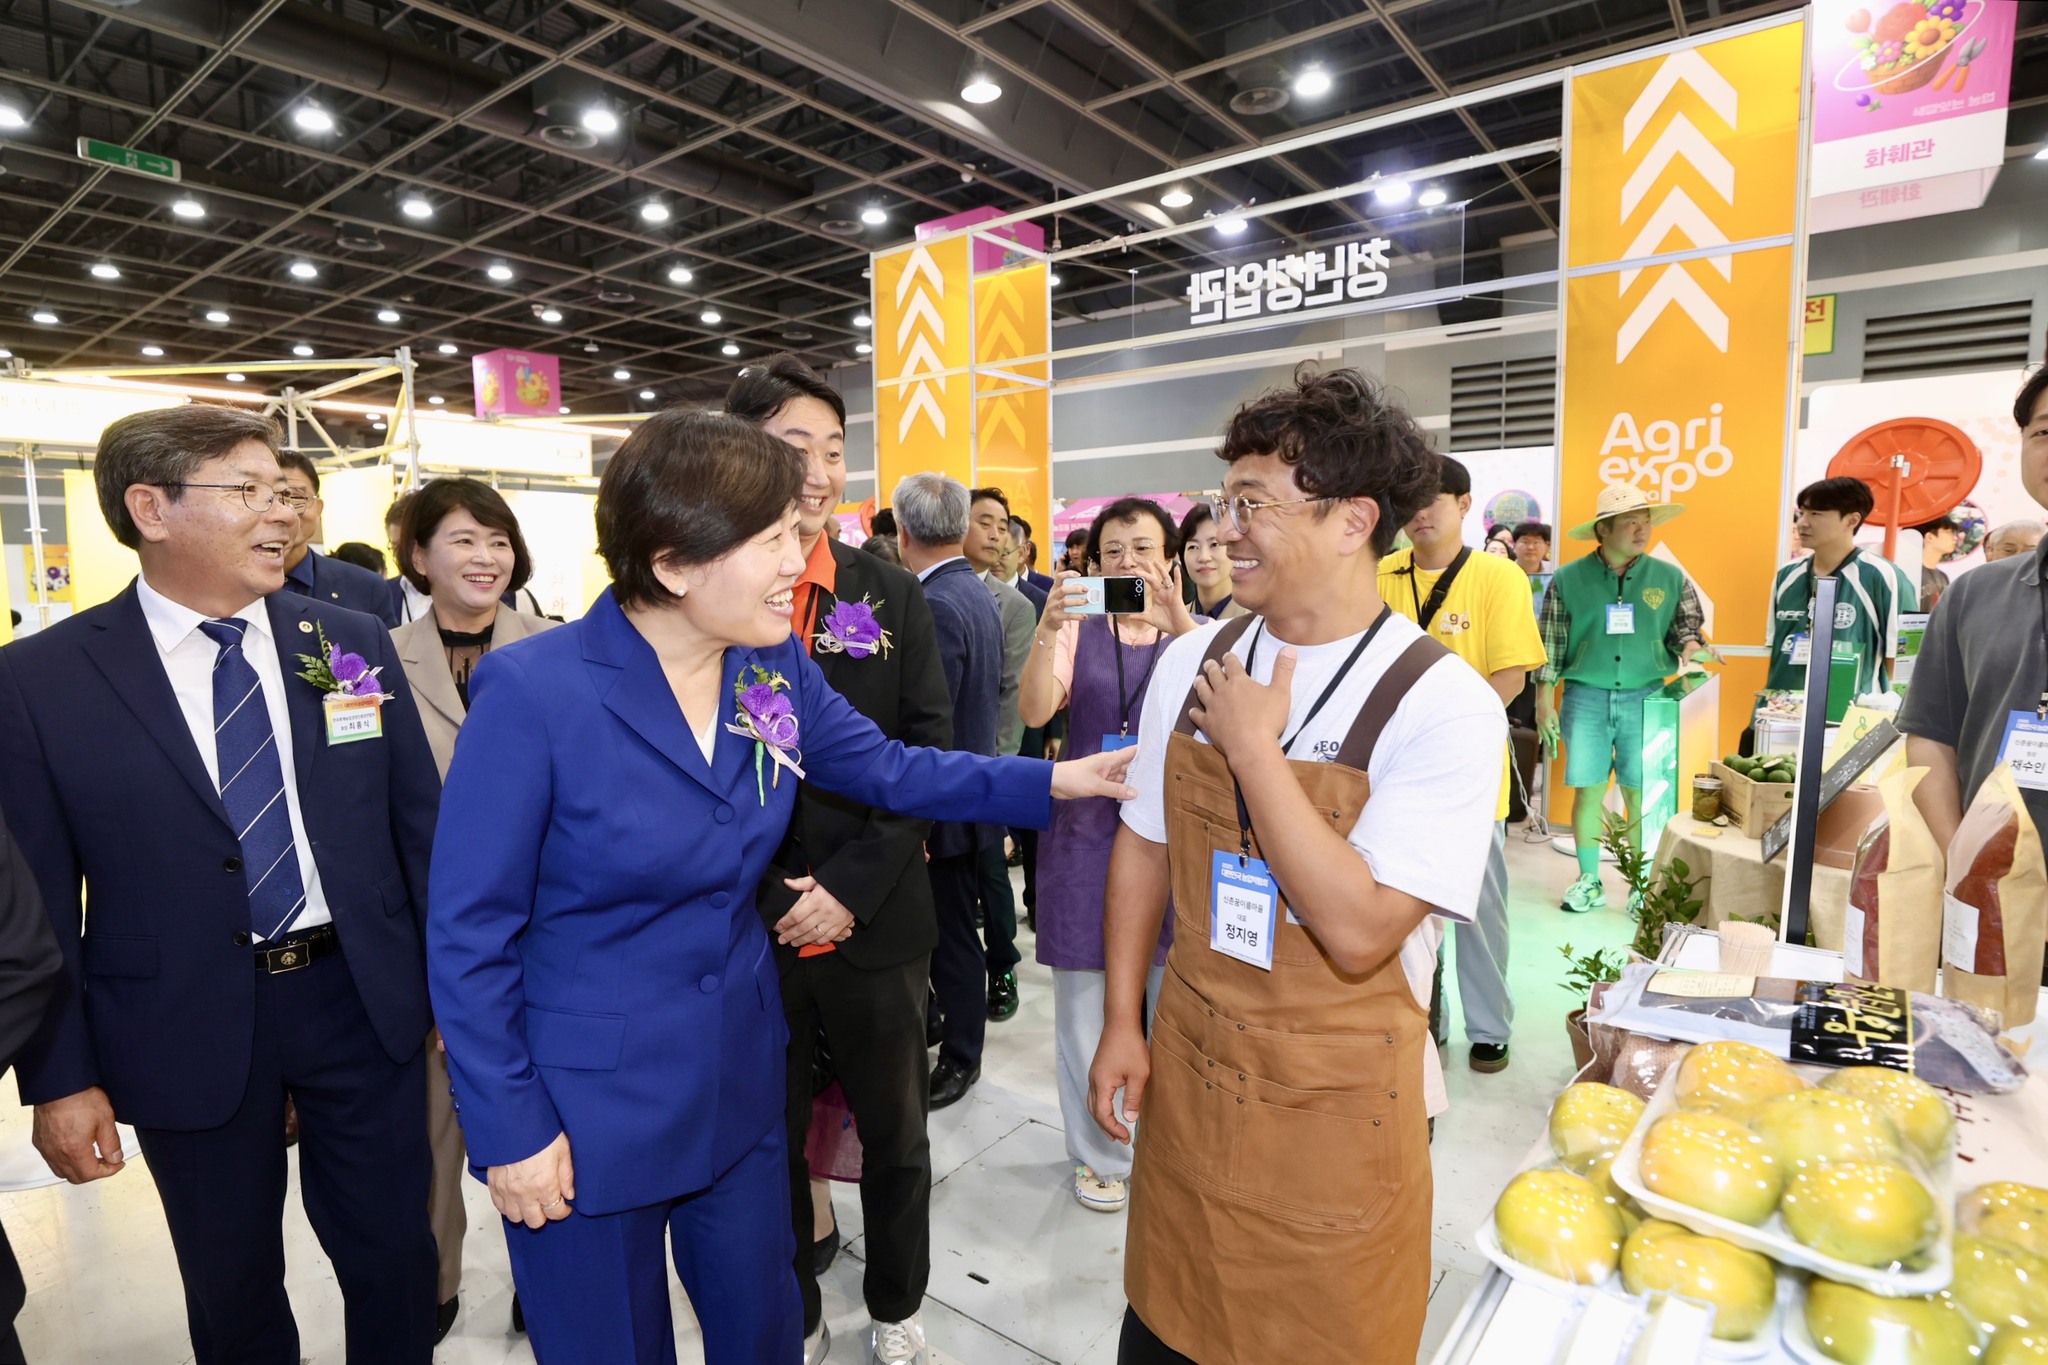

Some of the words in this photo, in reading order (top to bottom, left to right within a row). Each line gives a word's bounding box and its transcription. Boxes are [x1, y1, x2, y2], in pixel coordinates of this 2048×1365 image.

[1864, 138, 1935, 169] 화훼관
[1599, 402, 1724, 464] Agri
[1598, 443, 1734, 504] expo
[1225, 923, 1258, 947] 정지영
